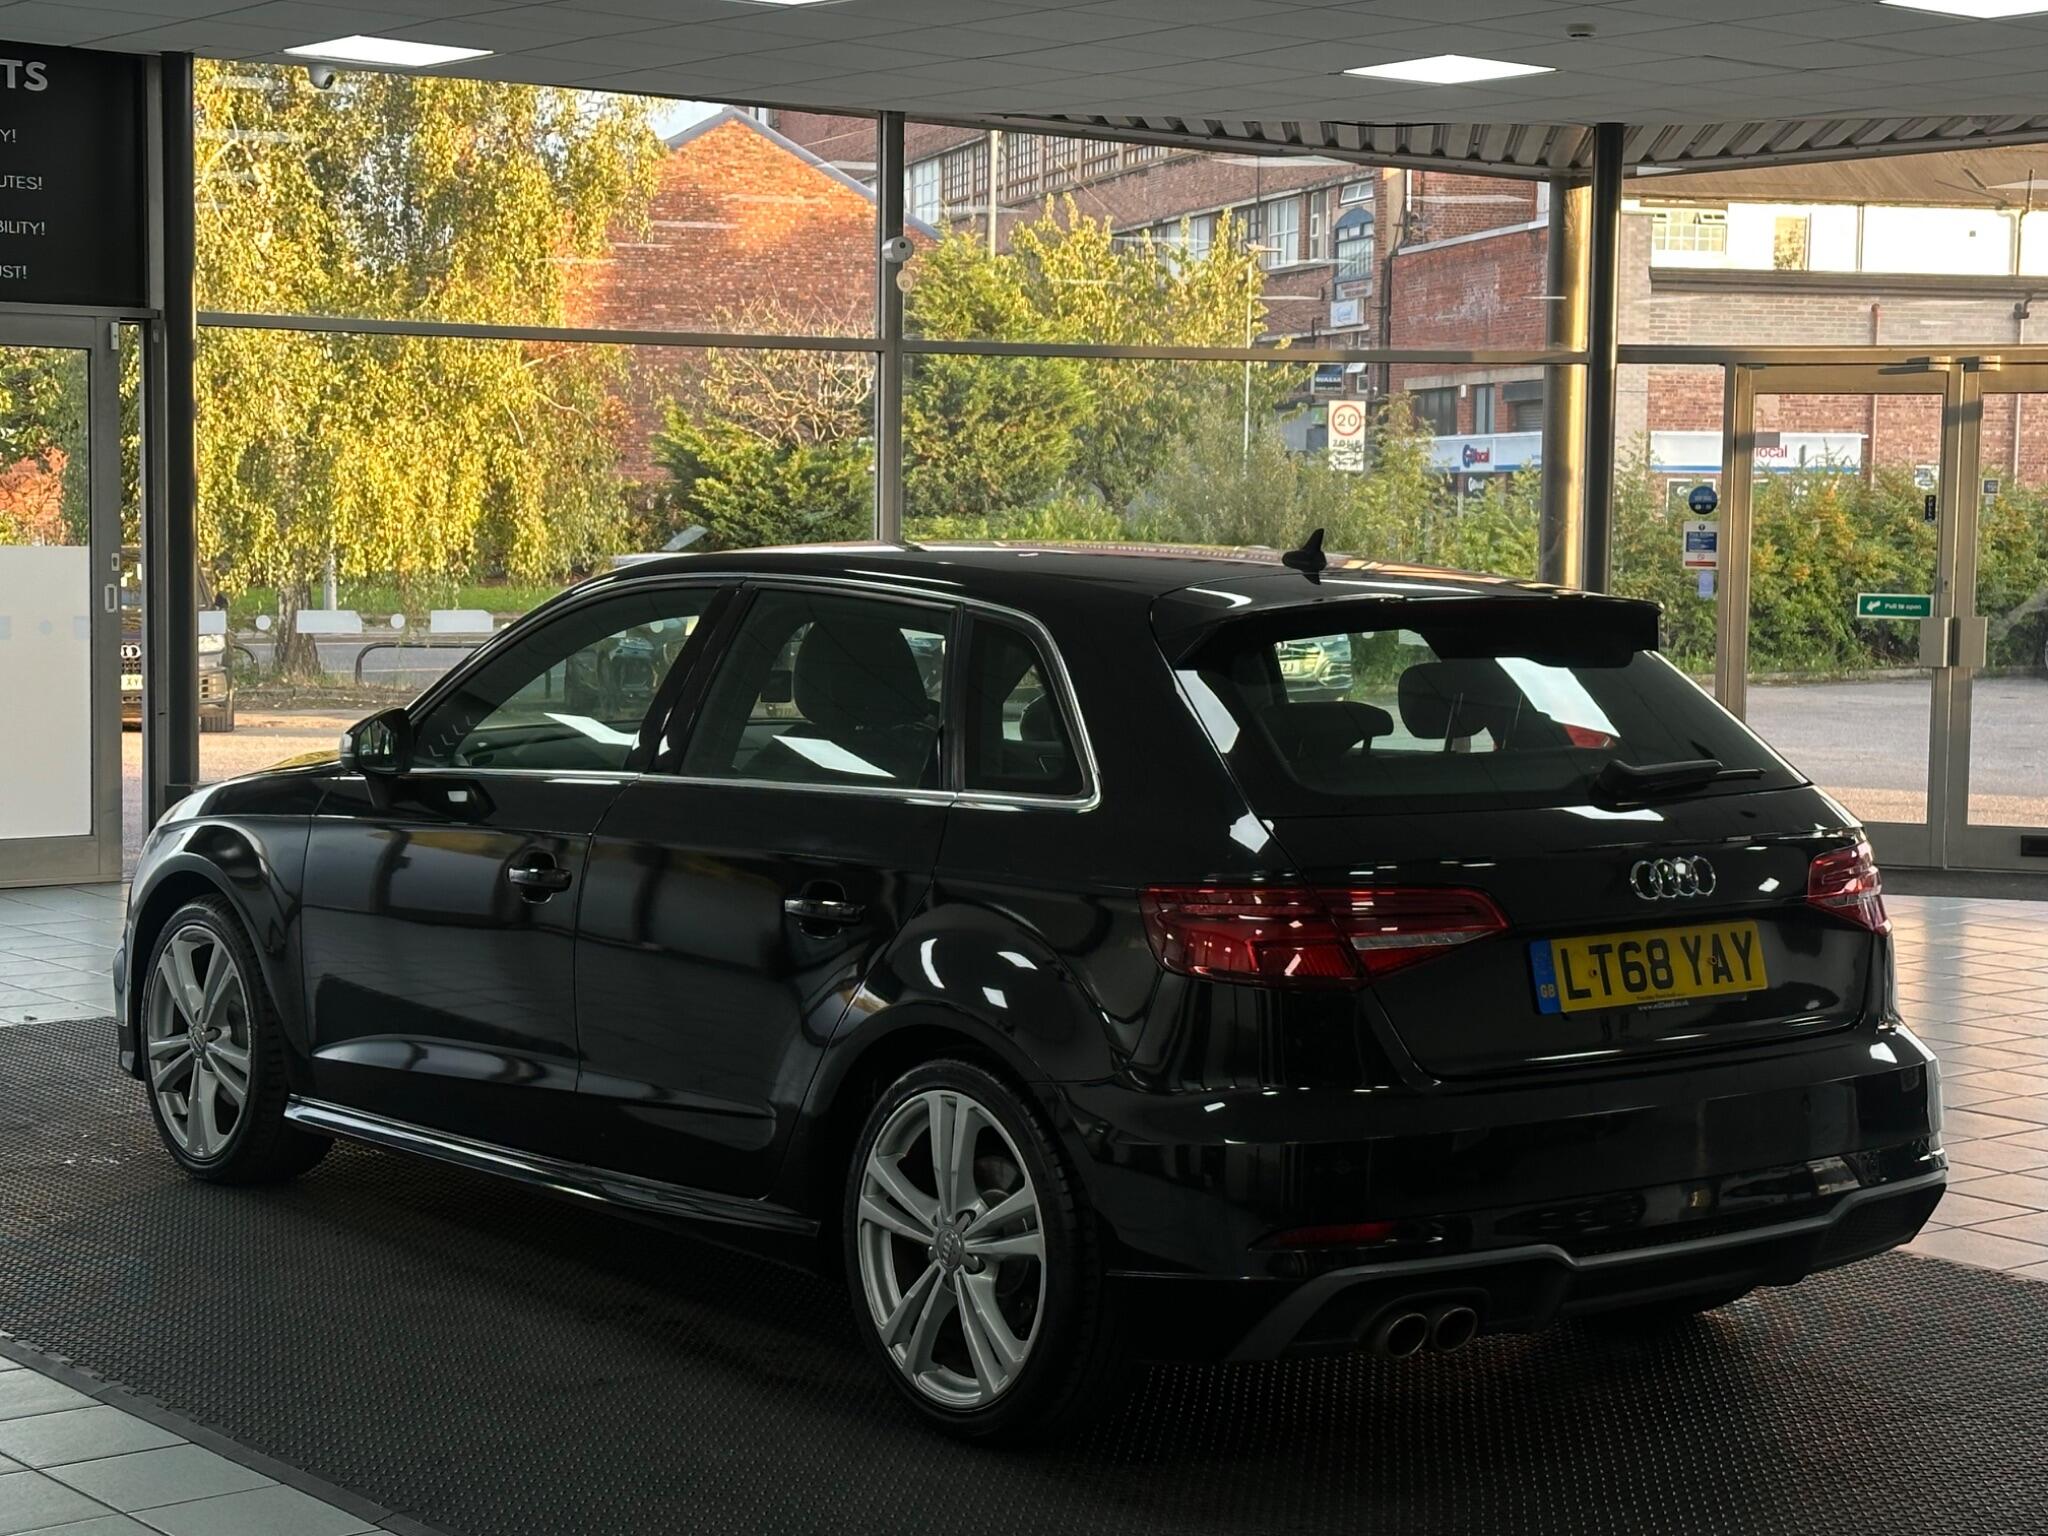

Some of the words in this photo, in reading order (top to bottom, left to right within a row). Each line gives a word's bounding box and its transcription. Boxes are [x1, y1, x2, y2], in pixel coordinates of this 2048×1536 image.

[0, 59, 48, 92] TS
[0, 265, 27, 279] ST!
[1337, 413, 1358, 427] 20
[1756, 444, 1788, 458] local
[1560, 938, 1675, 1000] LT68
[1680, 930, 1753, 986] YAY
[1540, 983, 1556, 998] GB
